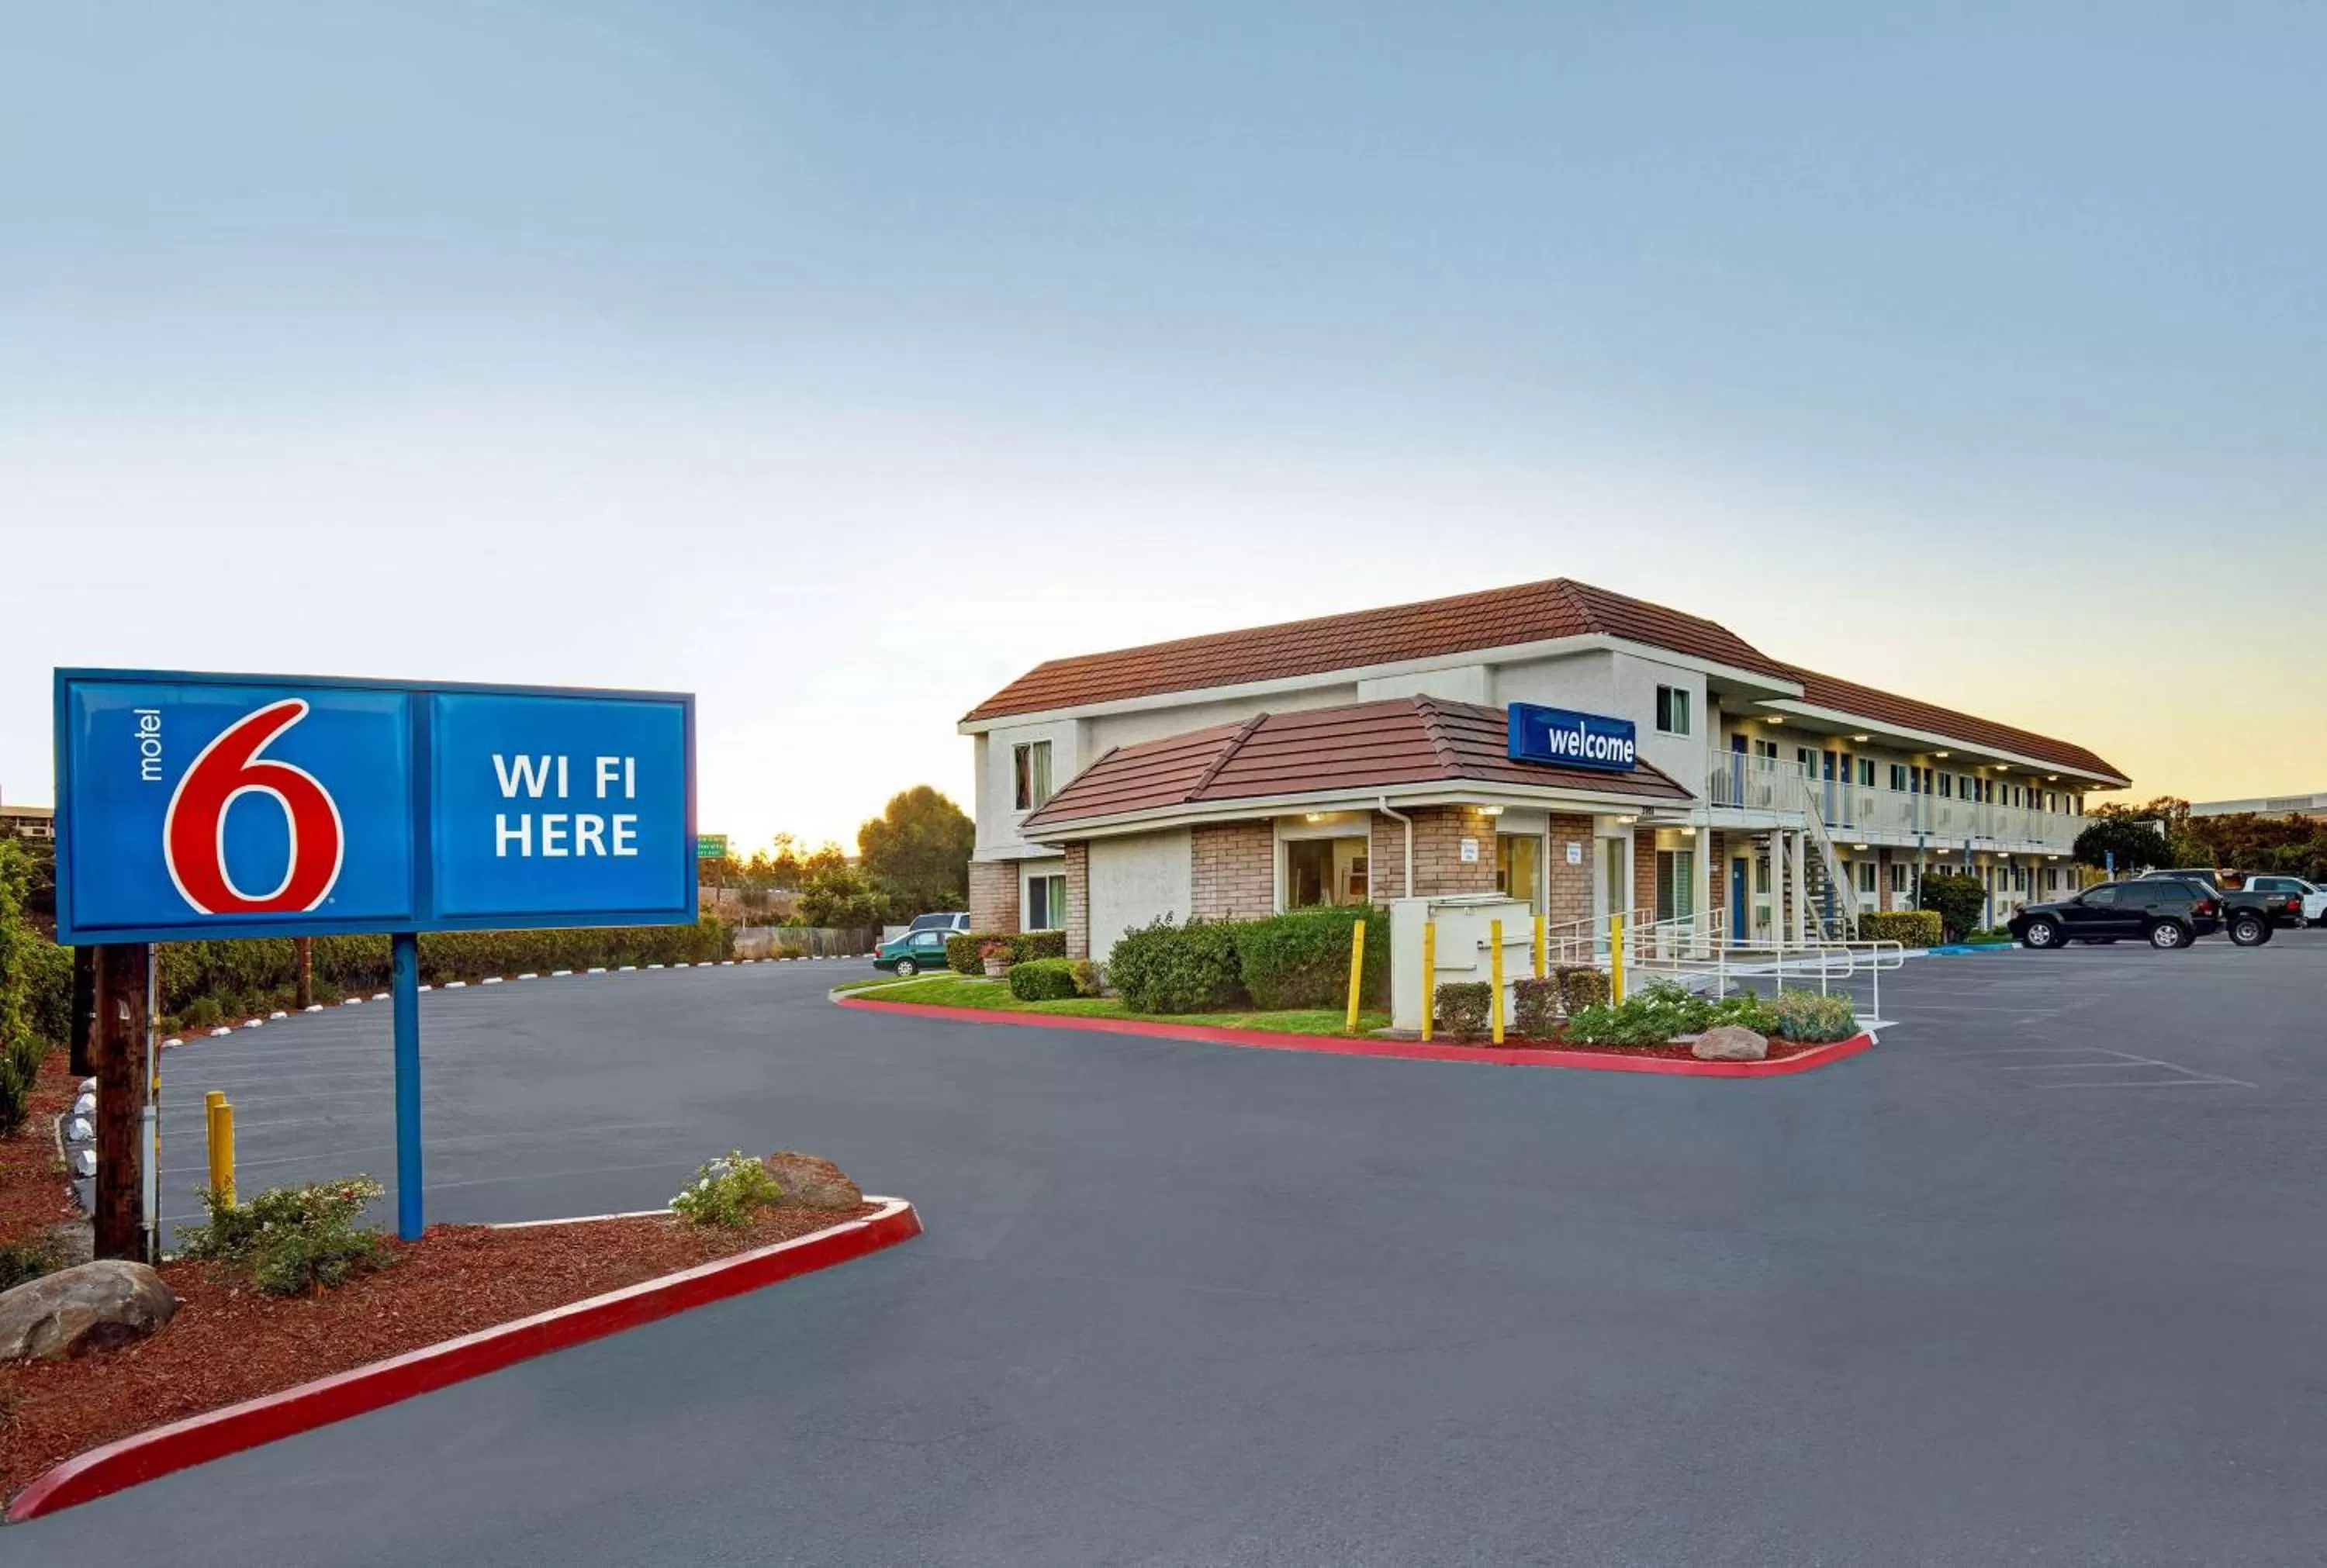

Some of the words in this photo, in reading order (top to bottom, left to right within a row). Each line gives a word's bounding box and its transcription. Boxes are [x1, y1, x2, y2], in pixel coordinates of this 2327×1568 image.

[133, 709, 162, 781] motel
[1549, 720, 1634, 762] welcome
[492, 754, 569, 798] WI
[596, 756, 635, 798] FI
[163, 697, 344, 914] 6
[496, 813, 638, 856] HERE
